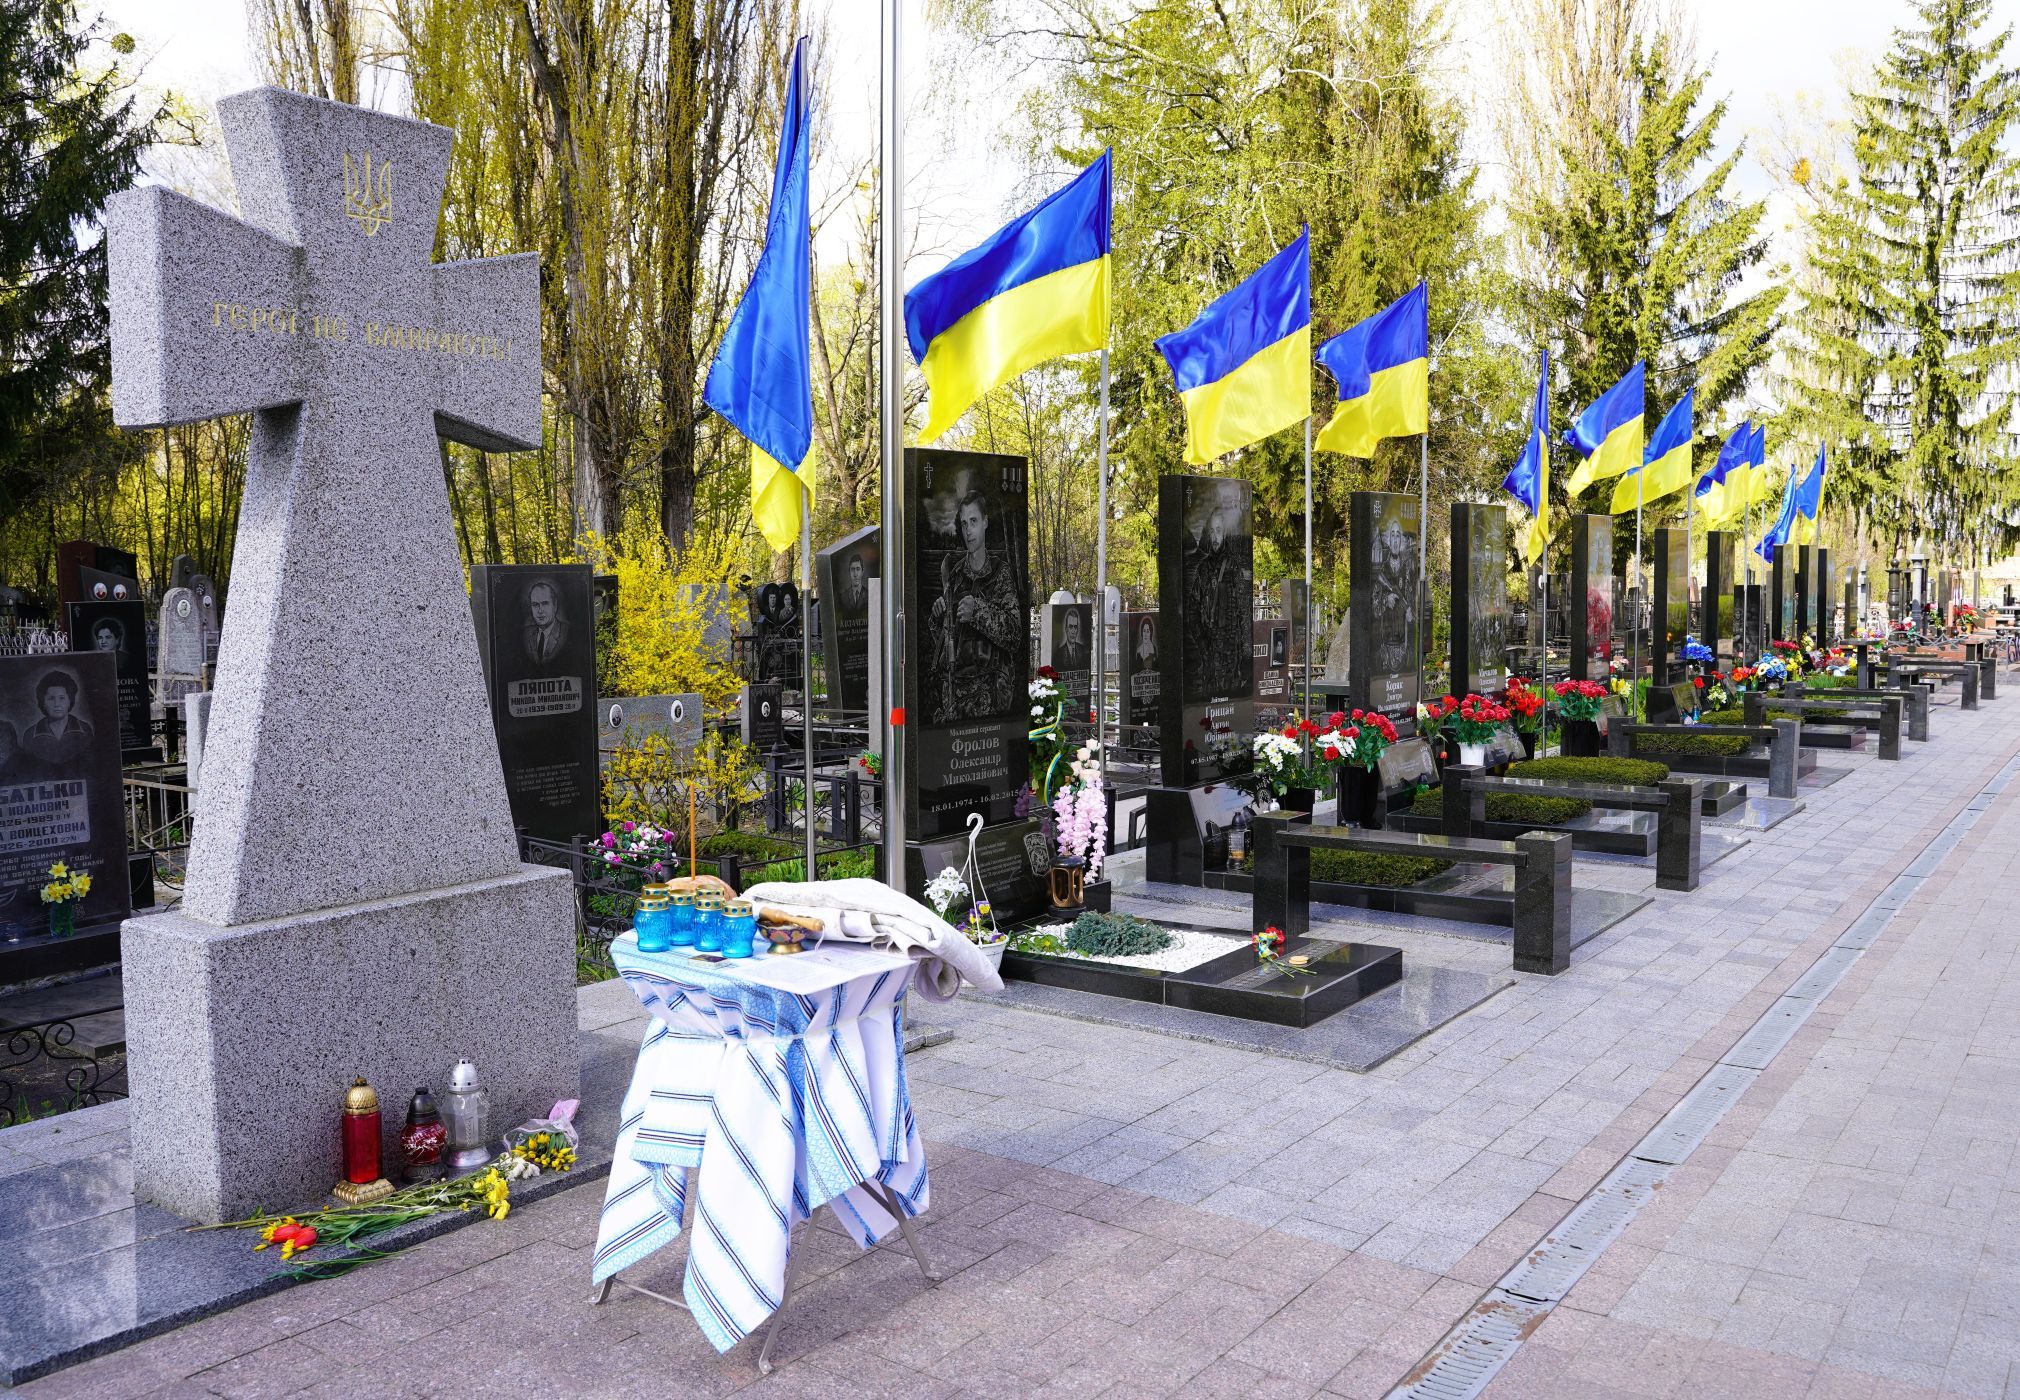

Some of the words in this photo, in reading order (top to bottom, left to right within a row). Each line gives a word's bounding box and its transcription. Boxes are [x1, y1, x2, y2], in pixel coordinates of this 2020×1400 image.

[951, 737, 1000, 757] Фролов
[950, 754, 1002, 770] Олександр
[942, 766, 1009, 786] Миколайович
[9, 800, 70, 817] ИВАНОВИЧ
